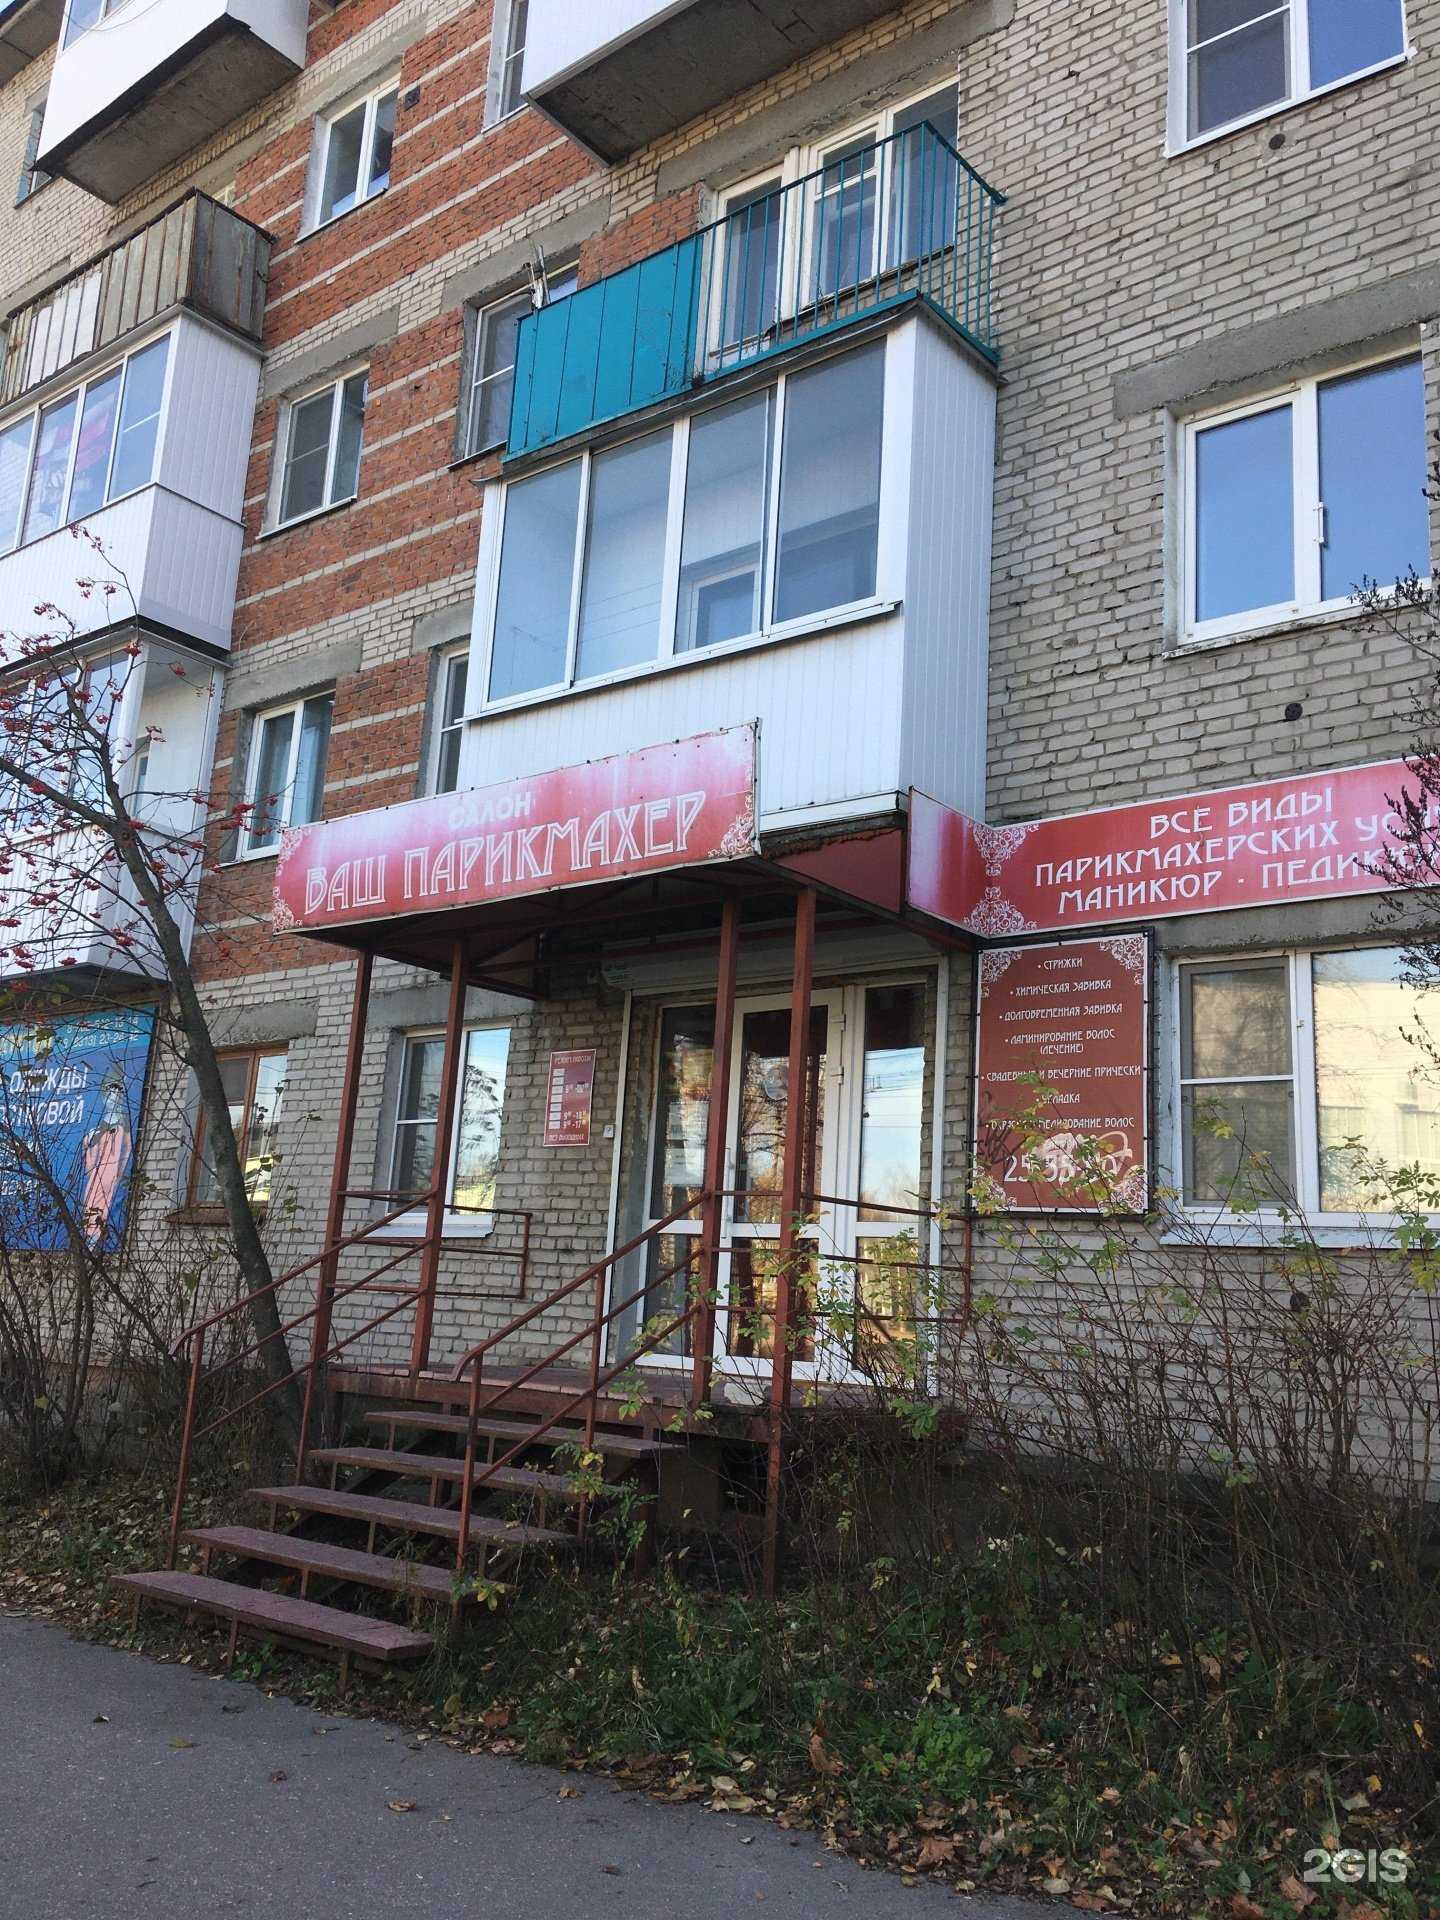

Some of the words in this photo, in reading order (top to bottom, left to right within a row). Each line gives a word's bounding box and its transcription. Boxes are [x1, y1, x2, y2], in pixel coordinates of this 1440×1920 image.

[447, 791, 532, 830] САЛОН
[1150, 807, 1213, 840] ВСЕ
[1227, 787, 1333, 827] ВИДЫ
[303, 854, 388, 915] ВАШ
[404, 790, 706, 900] ПАРИКМАХЕР
[1035, 820, 1340, 887] ПАРИКМАХЕРСКИХ
[1058, 870, 1222, 915] МАНИКЮР
[1262, 842, 1440, 889] ПЕДИКЮ
[1043, 957, 1083, 970] СТРИЖКИ
[1015, 982, 1070, 997] ХИМИЧЕСКАЯ
[1072, 979, 1112, 992] ЗАВИВКА
[1004, 1006, 1080, 1021] ДОЛГОВРЕМЕННАЯ
[1083, 1003, 1123, 1016] ЗАВИВКА
[1010, 1030, 1083, 1045] ЛАМИНИРОВАНИЕ
[1086, 1028, 1116, 1040] ВОЛОС
[1040, 1044, 1084, 1055] (ЛЕЧЕНИЕ)
[1048, 1067, 1092, 1079] ВЕЧЕРНИЕ
[1094, 1065, 1141, 1077] ПРИЧЕСКИ
[1104, 1117, 1135, 1128] ВОЛОС
